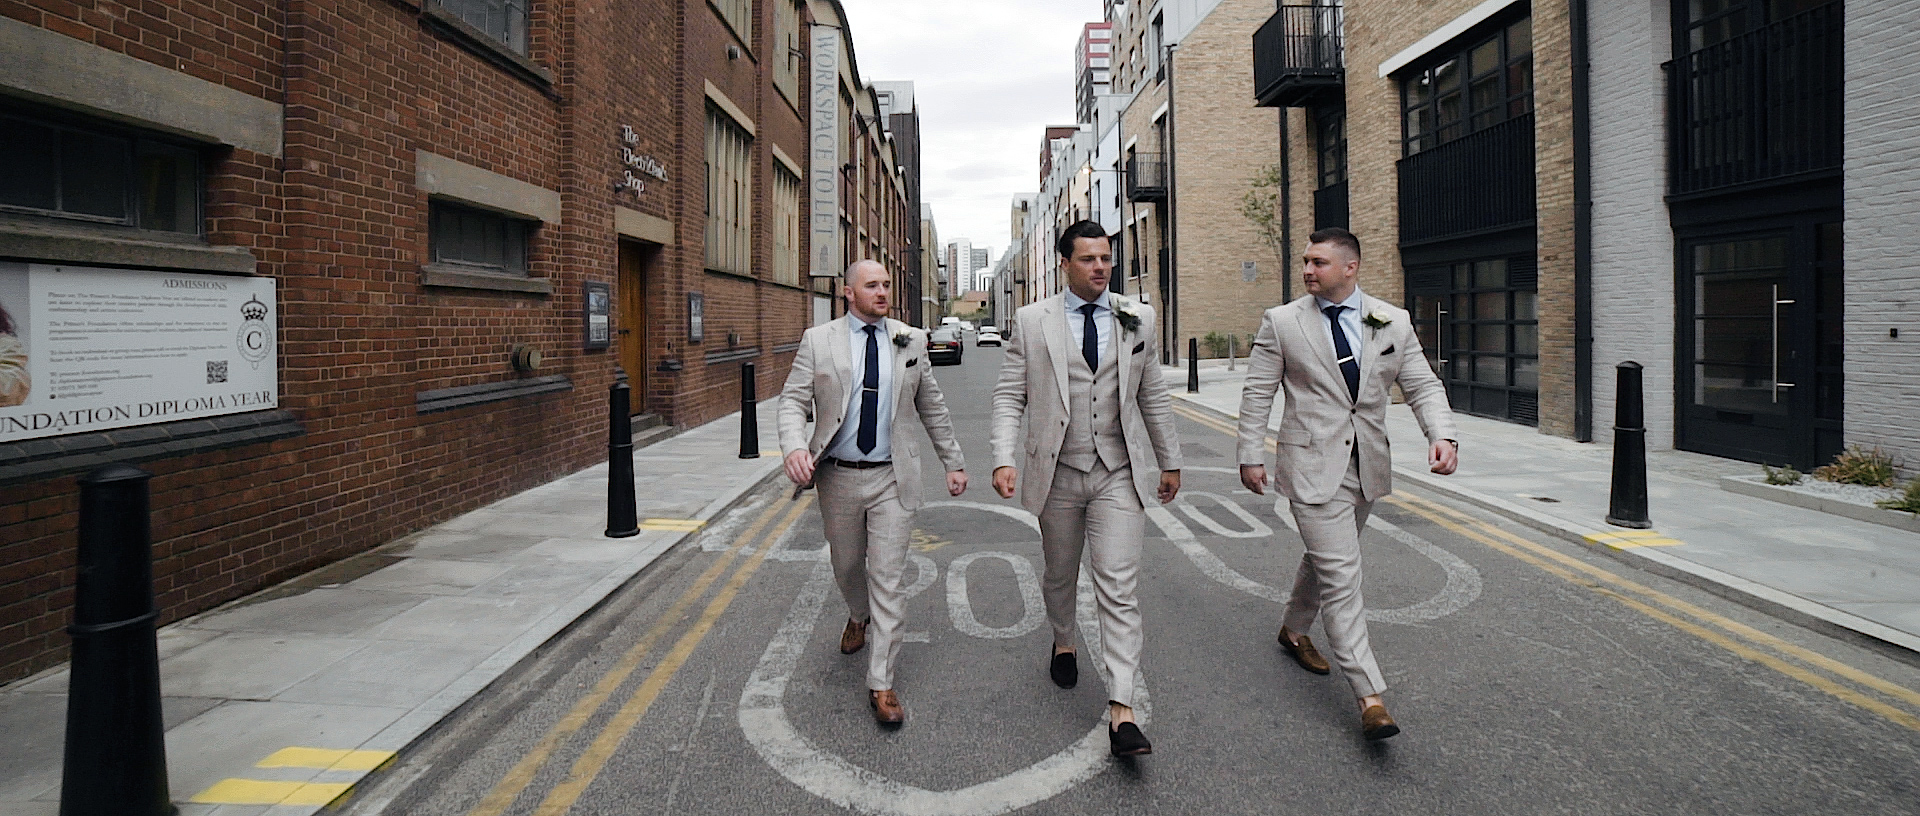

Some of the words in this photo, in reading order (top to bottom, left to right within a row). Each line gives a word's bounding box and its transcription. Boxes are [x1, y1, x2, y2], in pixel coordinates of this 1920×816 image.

[815, 36, 834, 160] WORKSPACE
[621, 124, 640, 146] The
[623, 170, 645, 198] Shop
[815, 166, 834, 193] TO
[815, 198, 834, 239] LET
[162, 279, 227, 290] ADMISSIONS
[247, 331, 261, 349] C
[138, 395, 226, 418] DIPLOMA
[231, 391, 272, 407] YEAR
